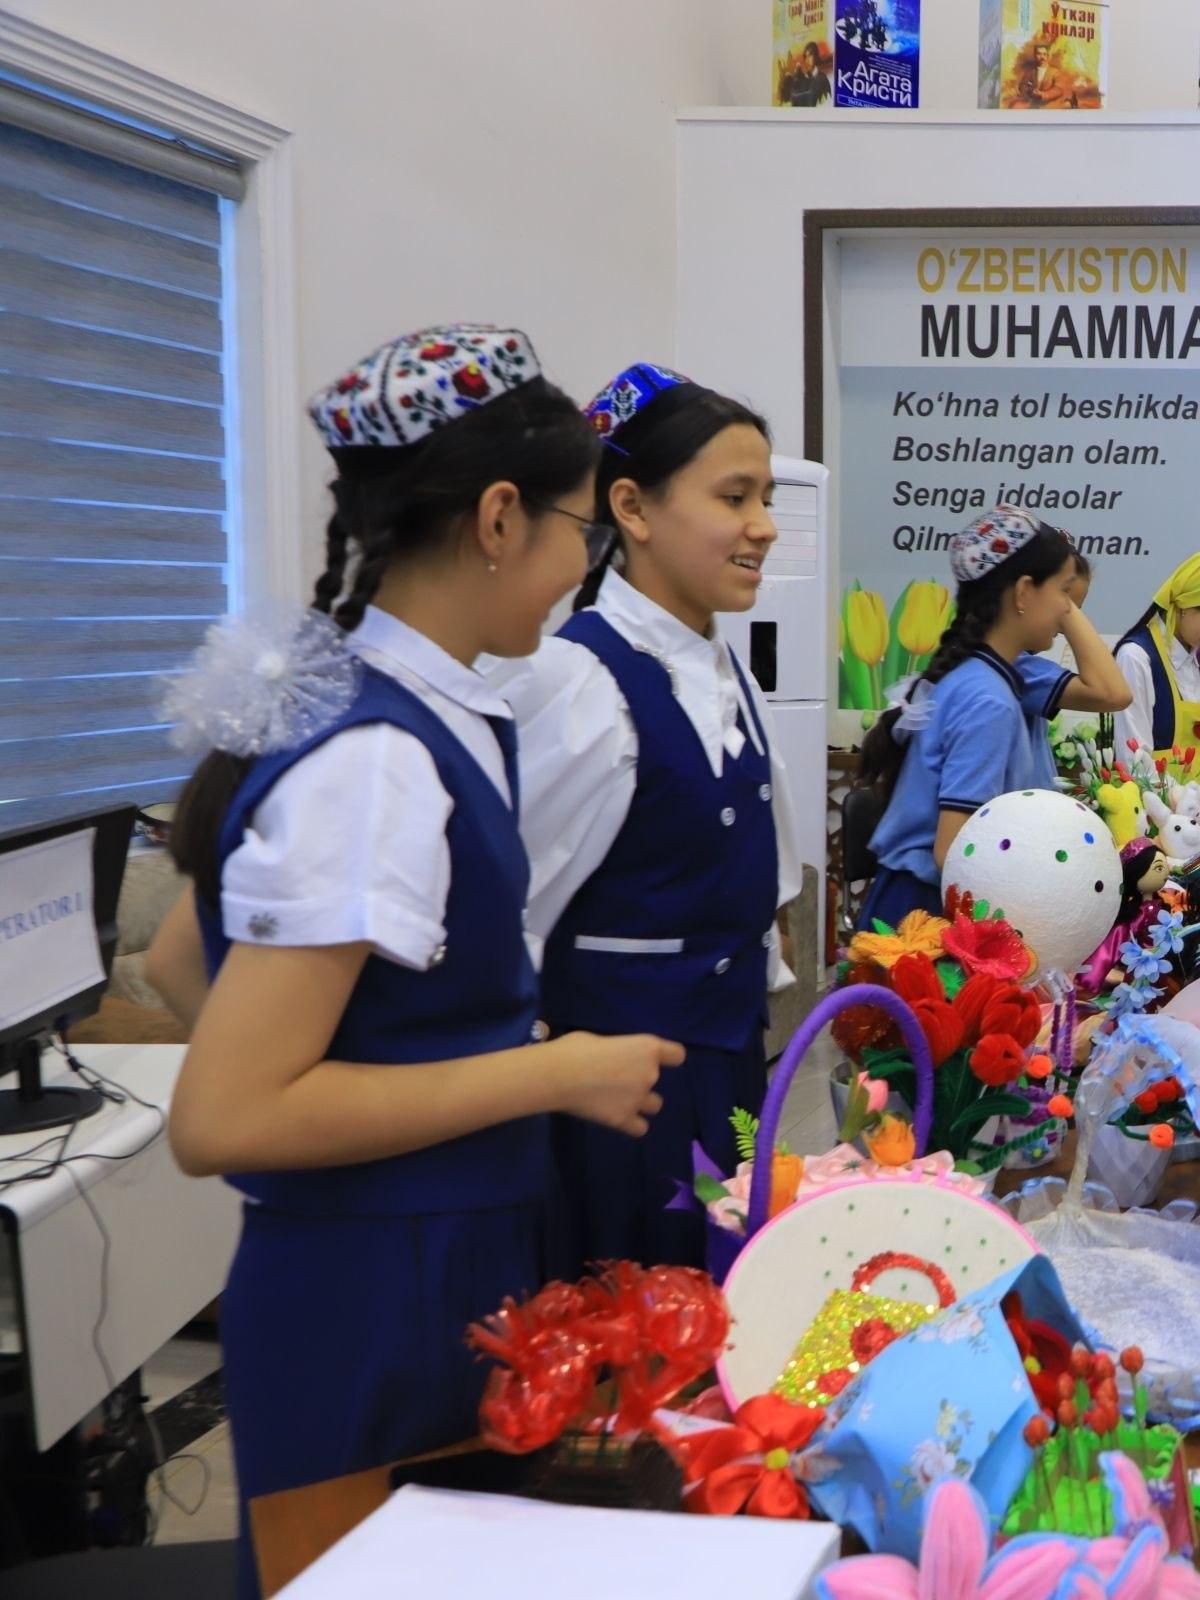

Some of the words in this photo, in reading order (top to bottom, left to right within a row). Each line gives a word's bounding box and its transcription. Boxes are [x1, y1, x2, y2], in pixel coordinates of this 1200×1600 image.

[837, 68, 912, 107] Кристи
[853, 60, 912, 93] Агата
[1010, 392, 1049, 418] tol
[892, 436, 1074, 470] Boshlangan
[1084, 439, 1167, 465] olam.
[892, 480, 986, 513] Senga
[995, 482, 1123, 510] iddaolar
[0, 895, 74, 940] ERATOR
